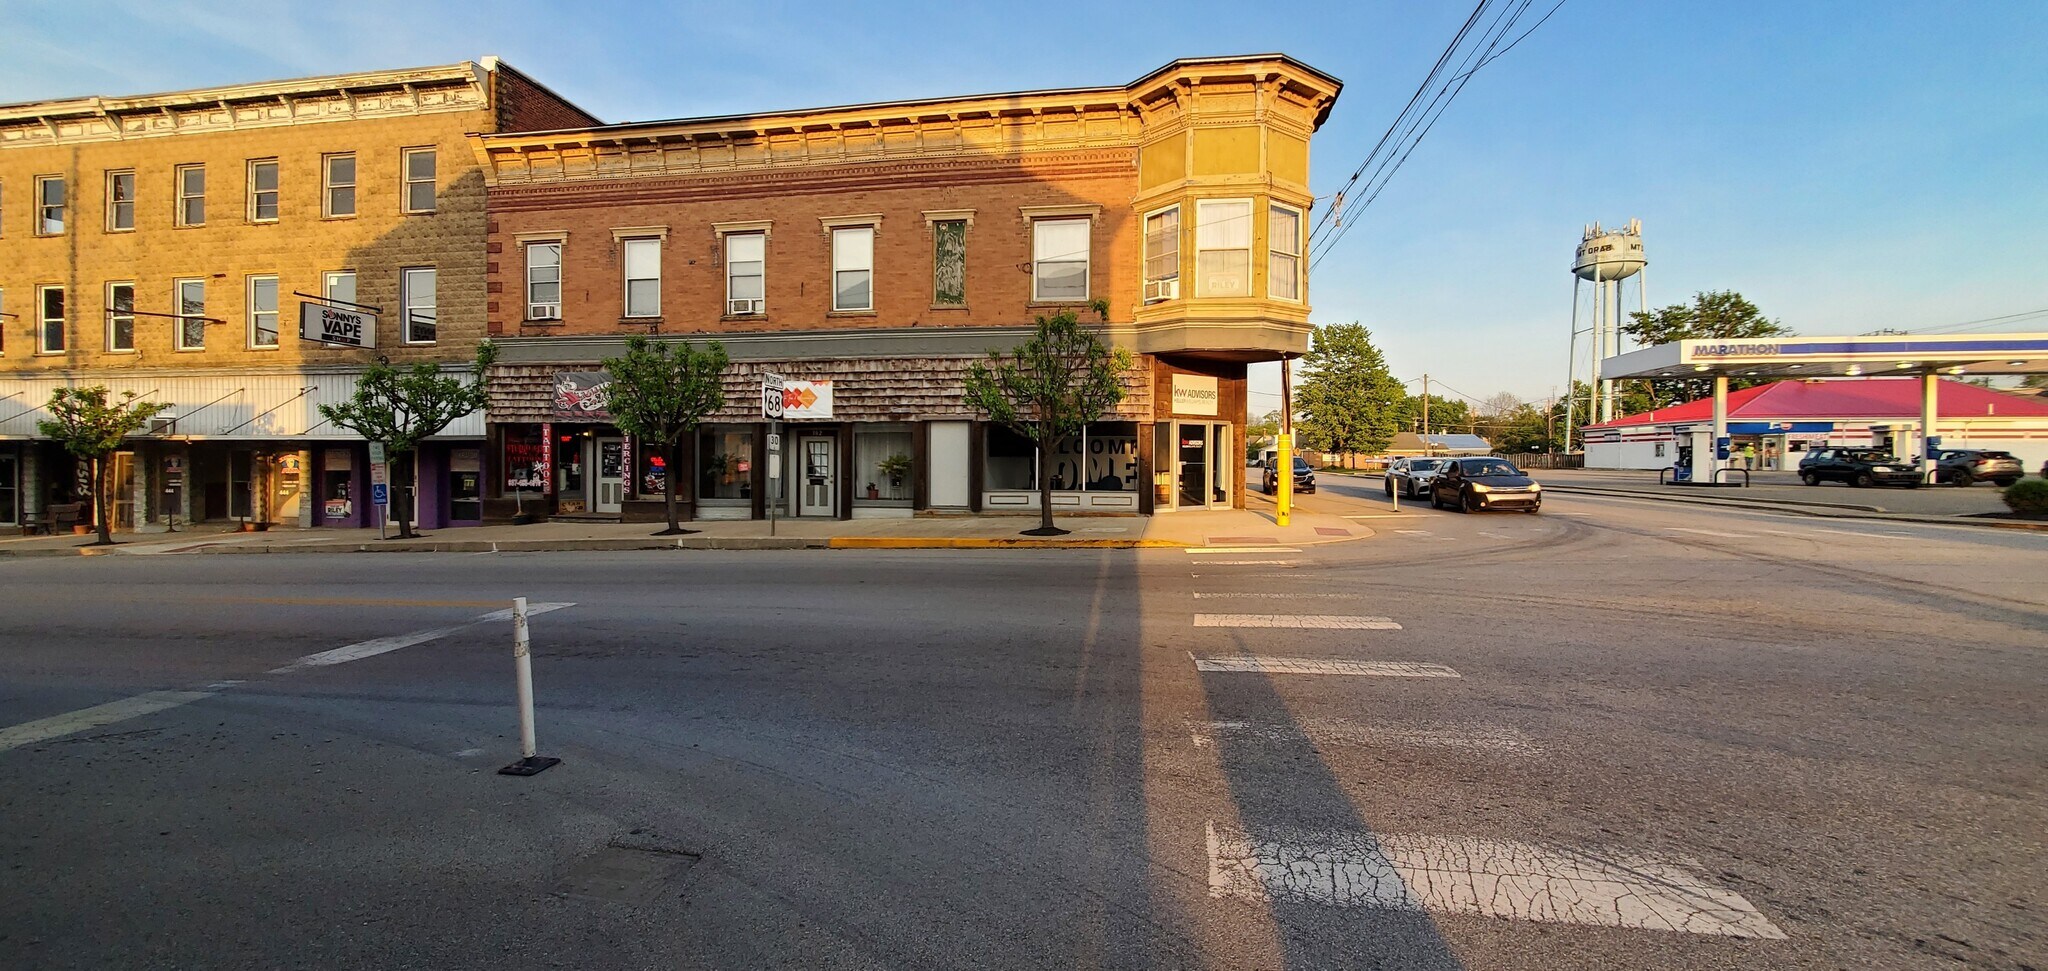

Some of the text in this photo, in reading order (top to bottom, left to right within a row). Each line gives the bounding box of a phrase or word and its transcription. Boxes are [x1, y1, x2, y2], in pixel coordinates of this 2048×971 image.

[322, 310, 361, 325] SONNY'S
[322, 319, 361, 338] VAPE
[1693, 343, 1779, 357] MARATHON
[765, 373, 783, 387] NORTH
[1187, 389, 1216, 400] ADVISORS
[768, 395, 781, 412] 68
[770, 436, 779, 445] 30
